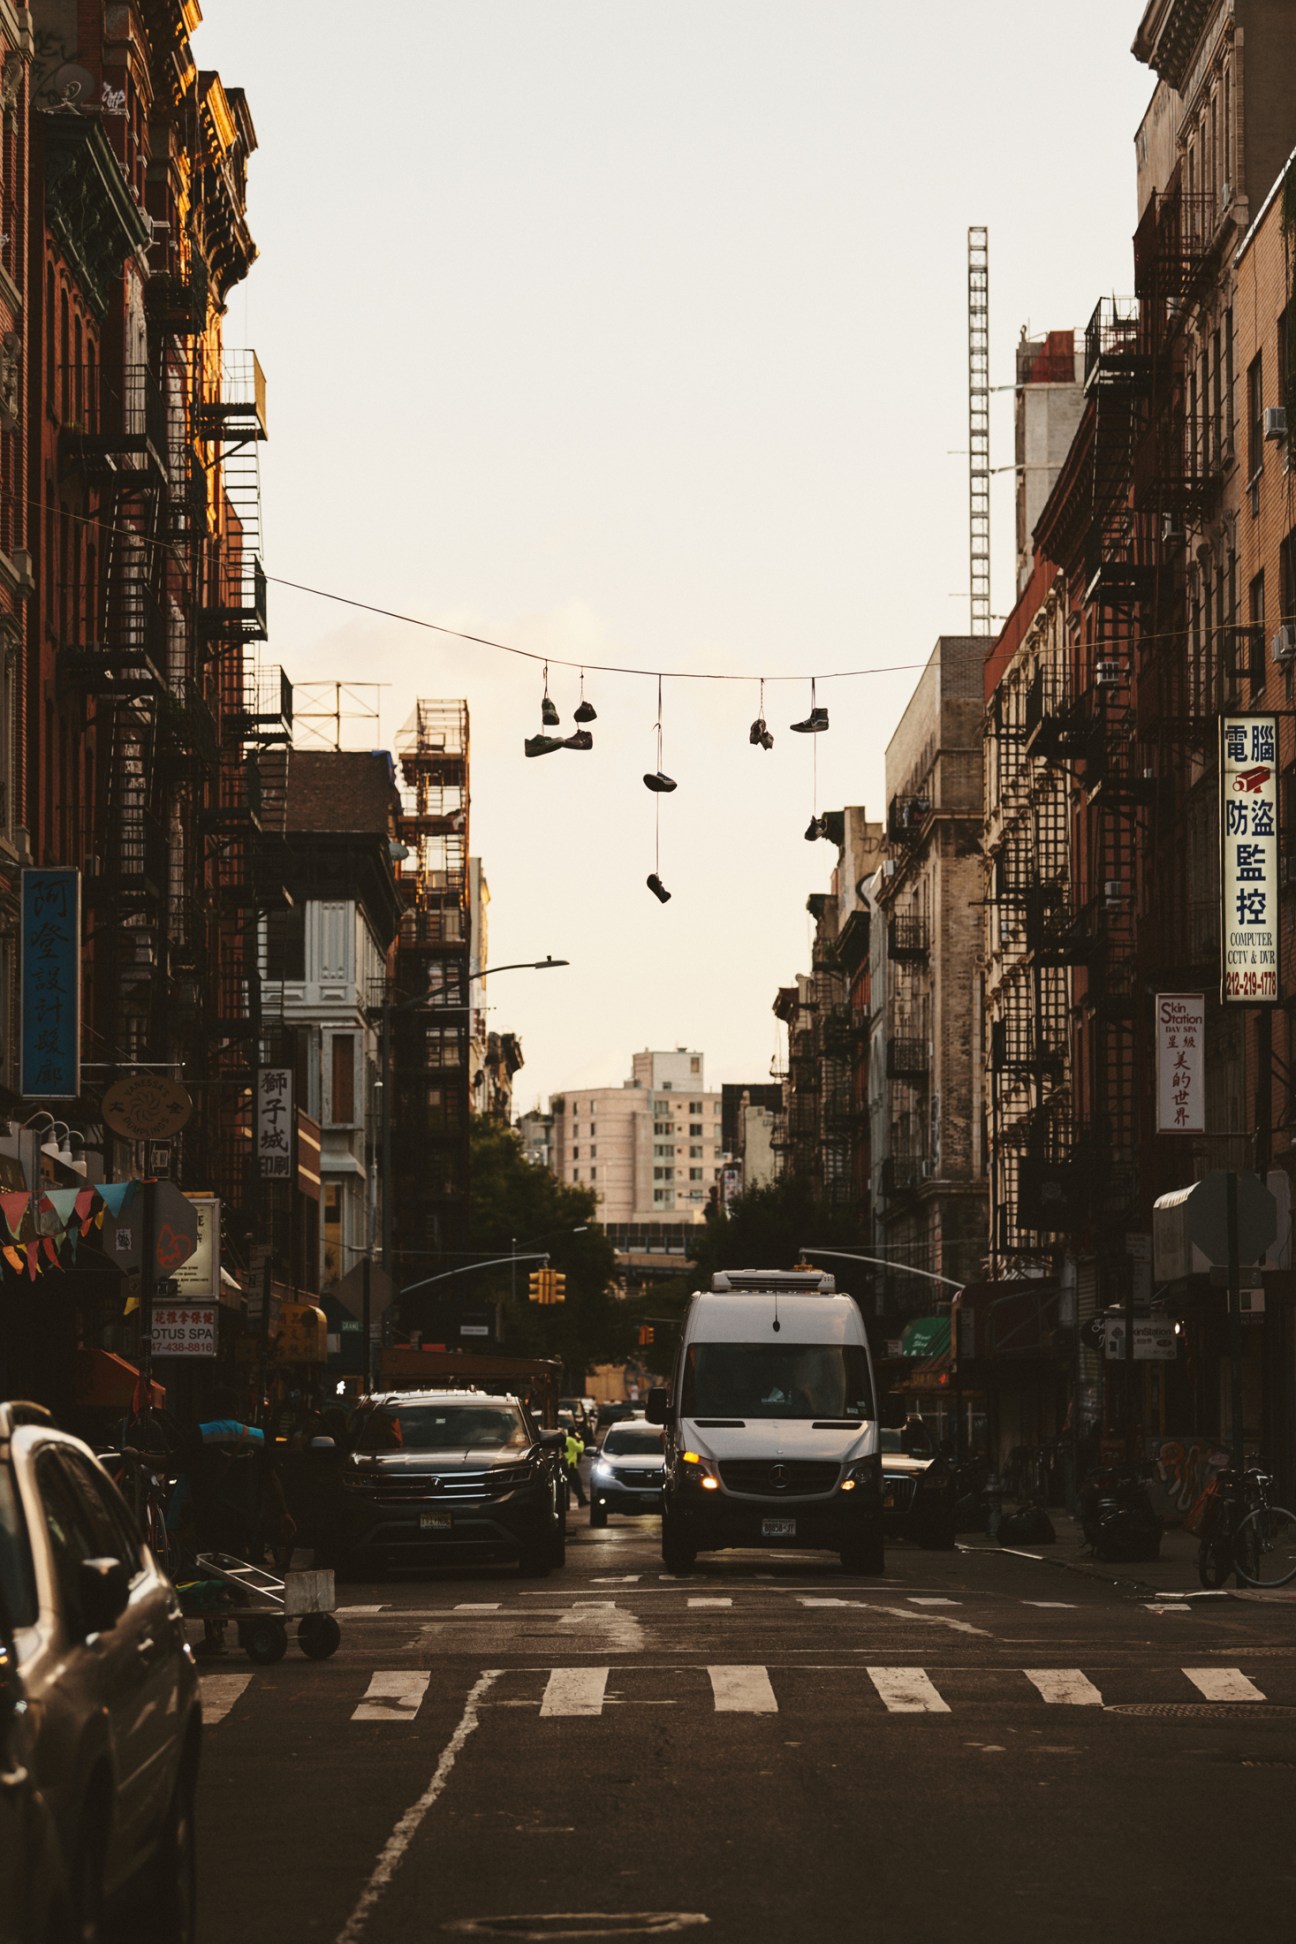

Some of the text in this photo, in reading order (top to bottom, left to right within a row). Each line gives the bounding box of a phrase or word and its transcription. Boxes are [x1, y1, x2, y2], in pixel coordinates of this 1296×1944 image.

[1225, 725, 1275, 763] 電腦
[1226, 799, 1275, 837] 防盜
[1236, 844, 1267, 925] 監控
[1230, 932, 1272, 947] COMPUTER
[1227, 950, 1275, 965] CCTV & DVR
[1226, 972, 1277, 997] 212-219-1778
[1161, 1002, 1186, 1020] Skin
[1161, 1007, 1203, 1024] Station
[1166, 1035, 1196, 1049] 星級
[1172, 1051, 1191, 1126] 美的世界
[260, 1072, 288, 1153] 獅子城
[123, 1116, 169, 1135] DUMPLINGS
[259, 1155, 290, 1176] 印刷
[151, 1328, 213, 1340] OTUS SPA
[1132, 1327, 1172, 1336] kinStation
